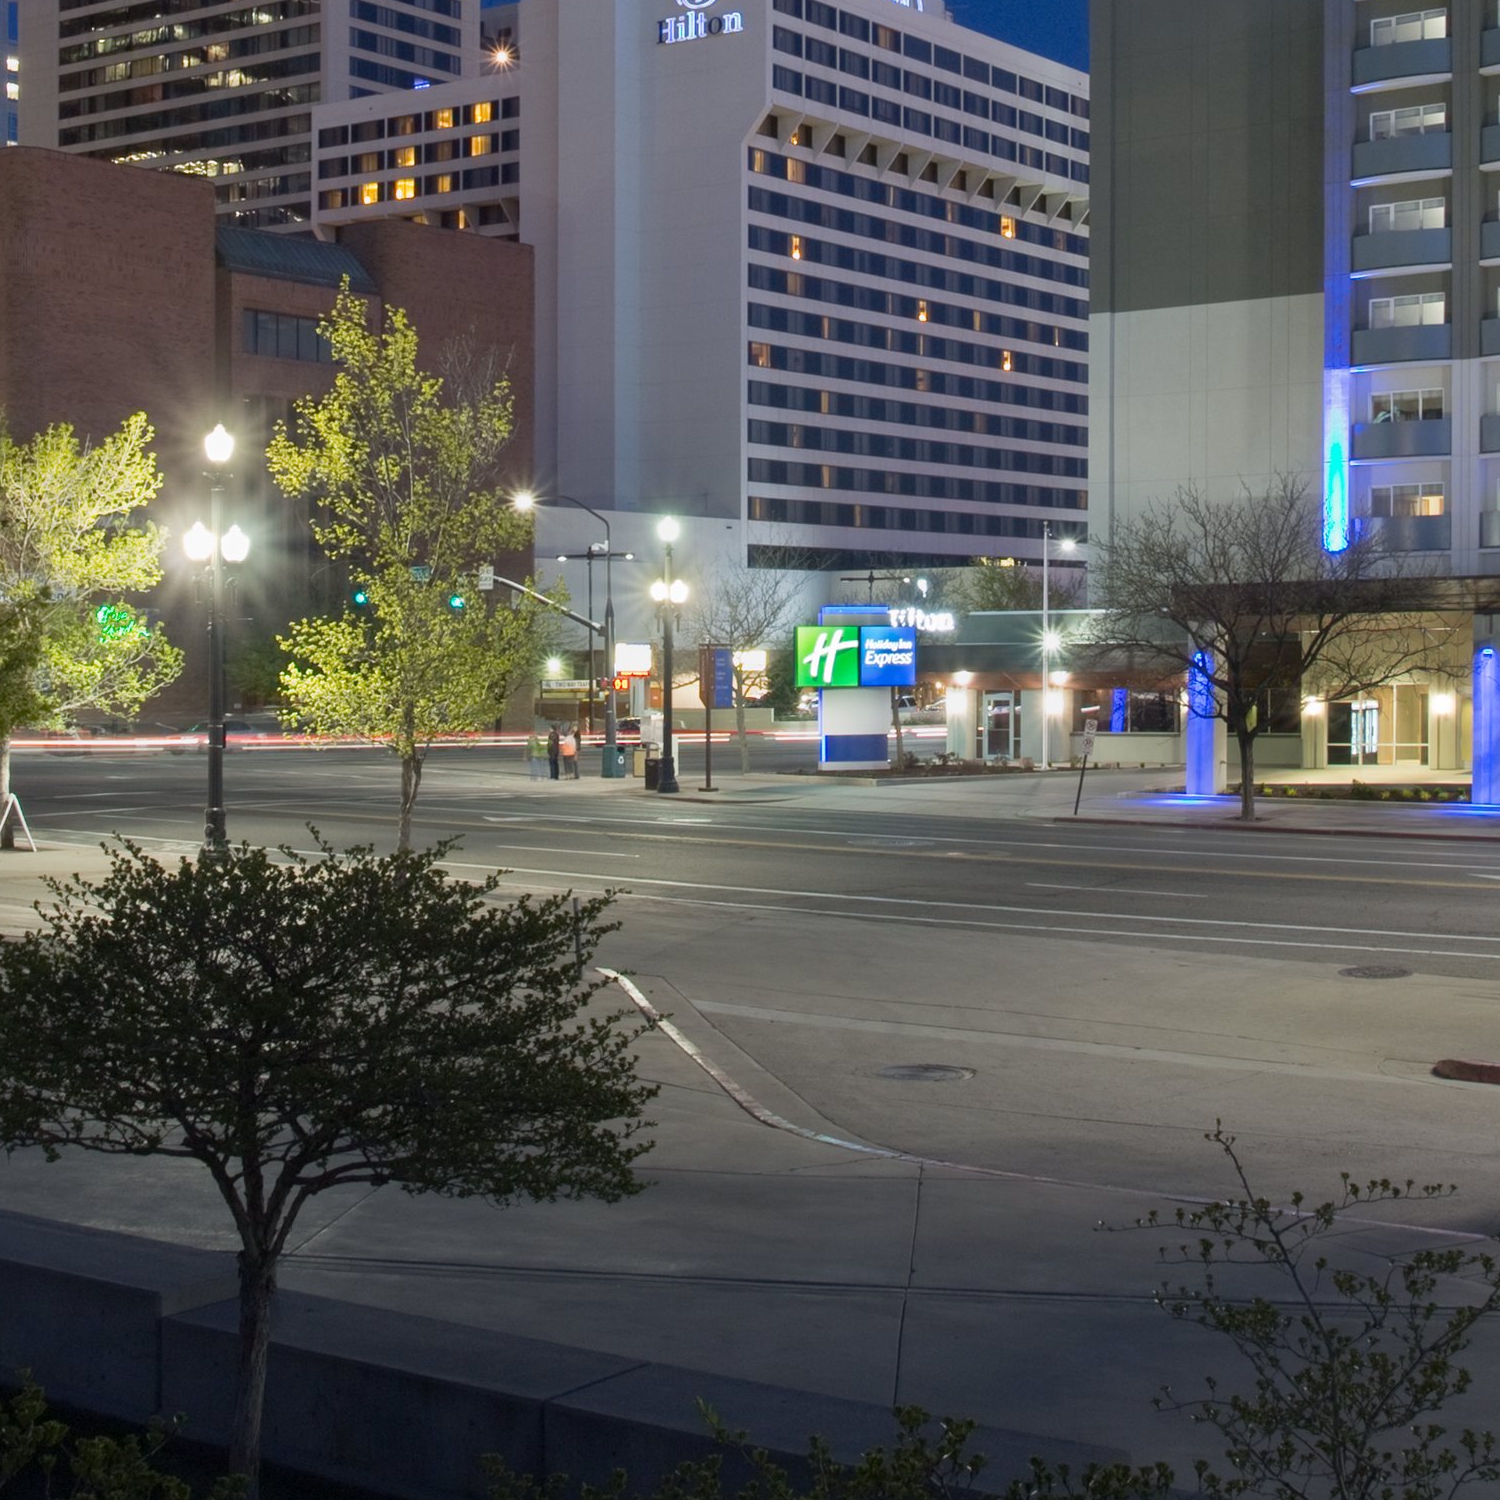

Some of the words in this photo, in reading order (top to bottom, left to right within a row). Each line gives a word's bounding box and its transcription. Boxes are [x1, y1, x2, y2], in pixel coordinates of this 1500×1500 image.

[656, 10, 744, 45] Hilton
[864, 638, 898, 651] Holiday
[899, 638, 913, 649] Inn
[864, 650, 913, 668] Express
